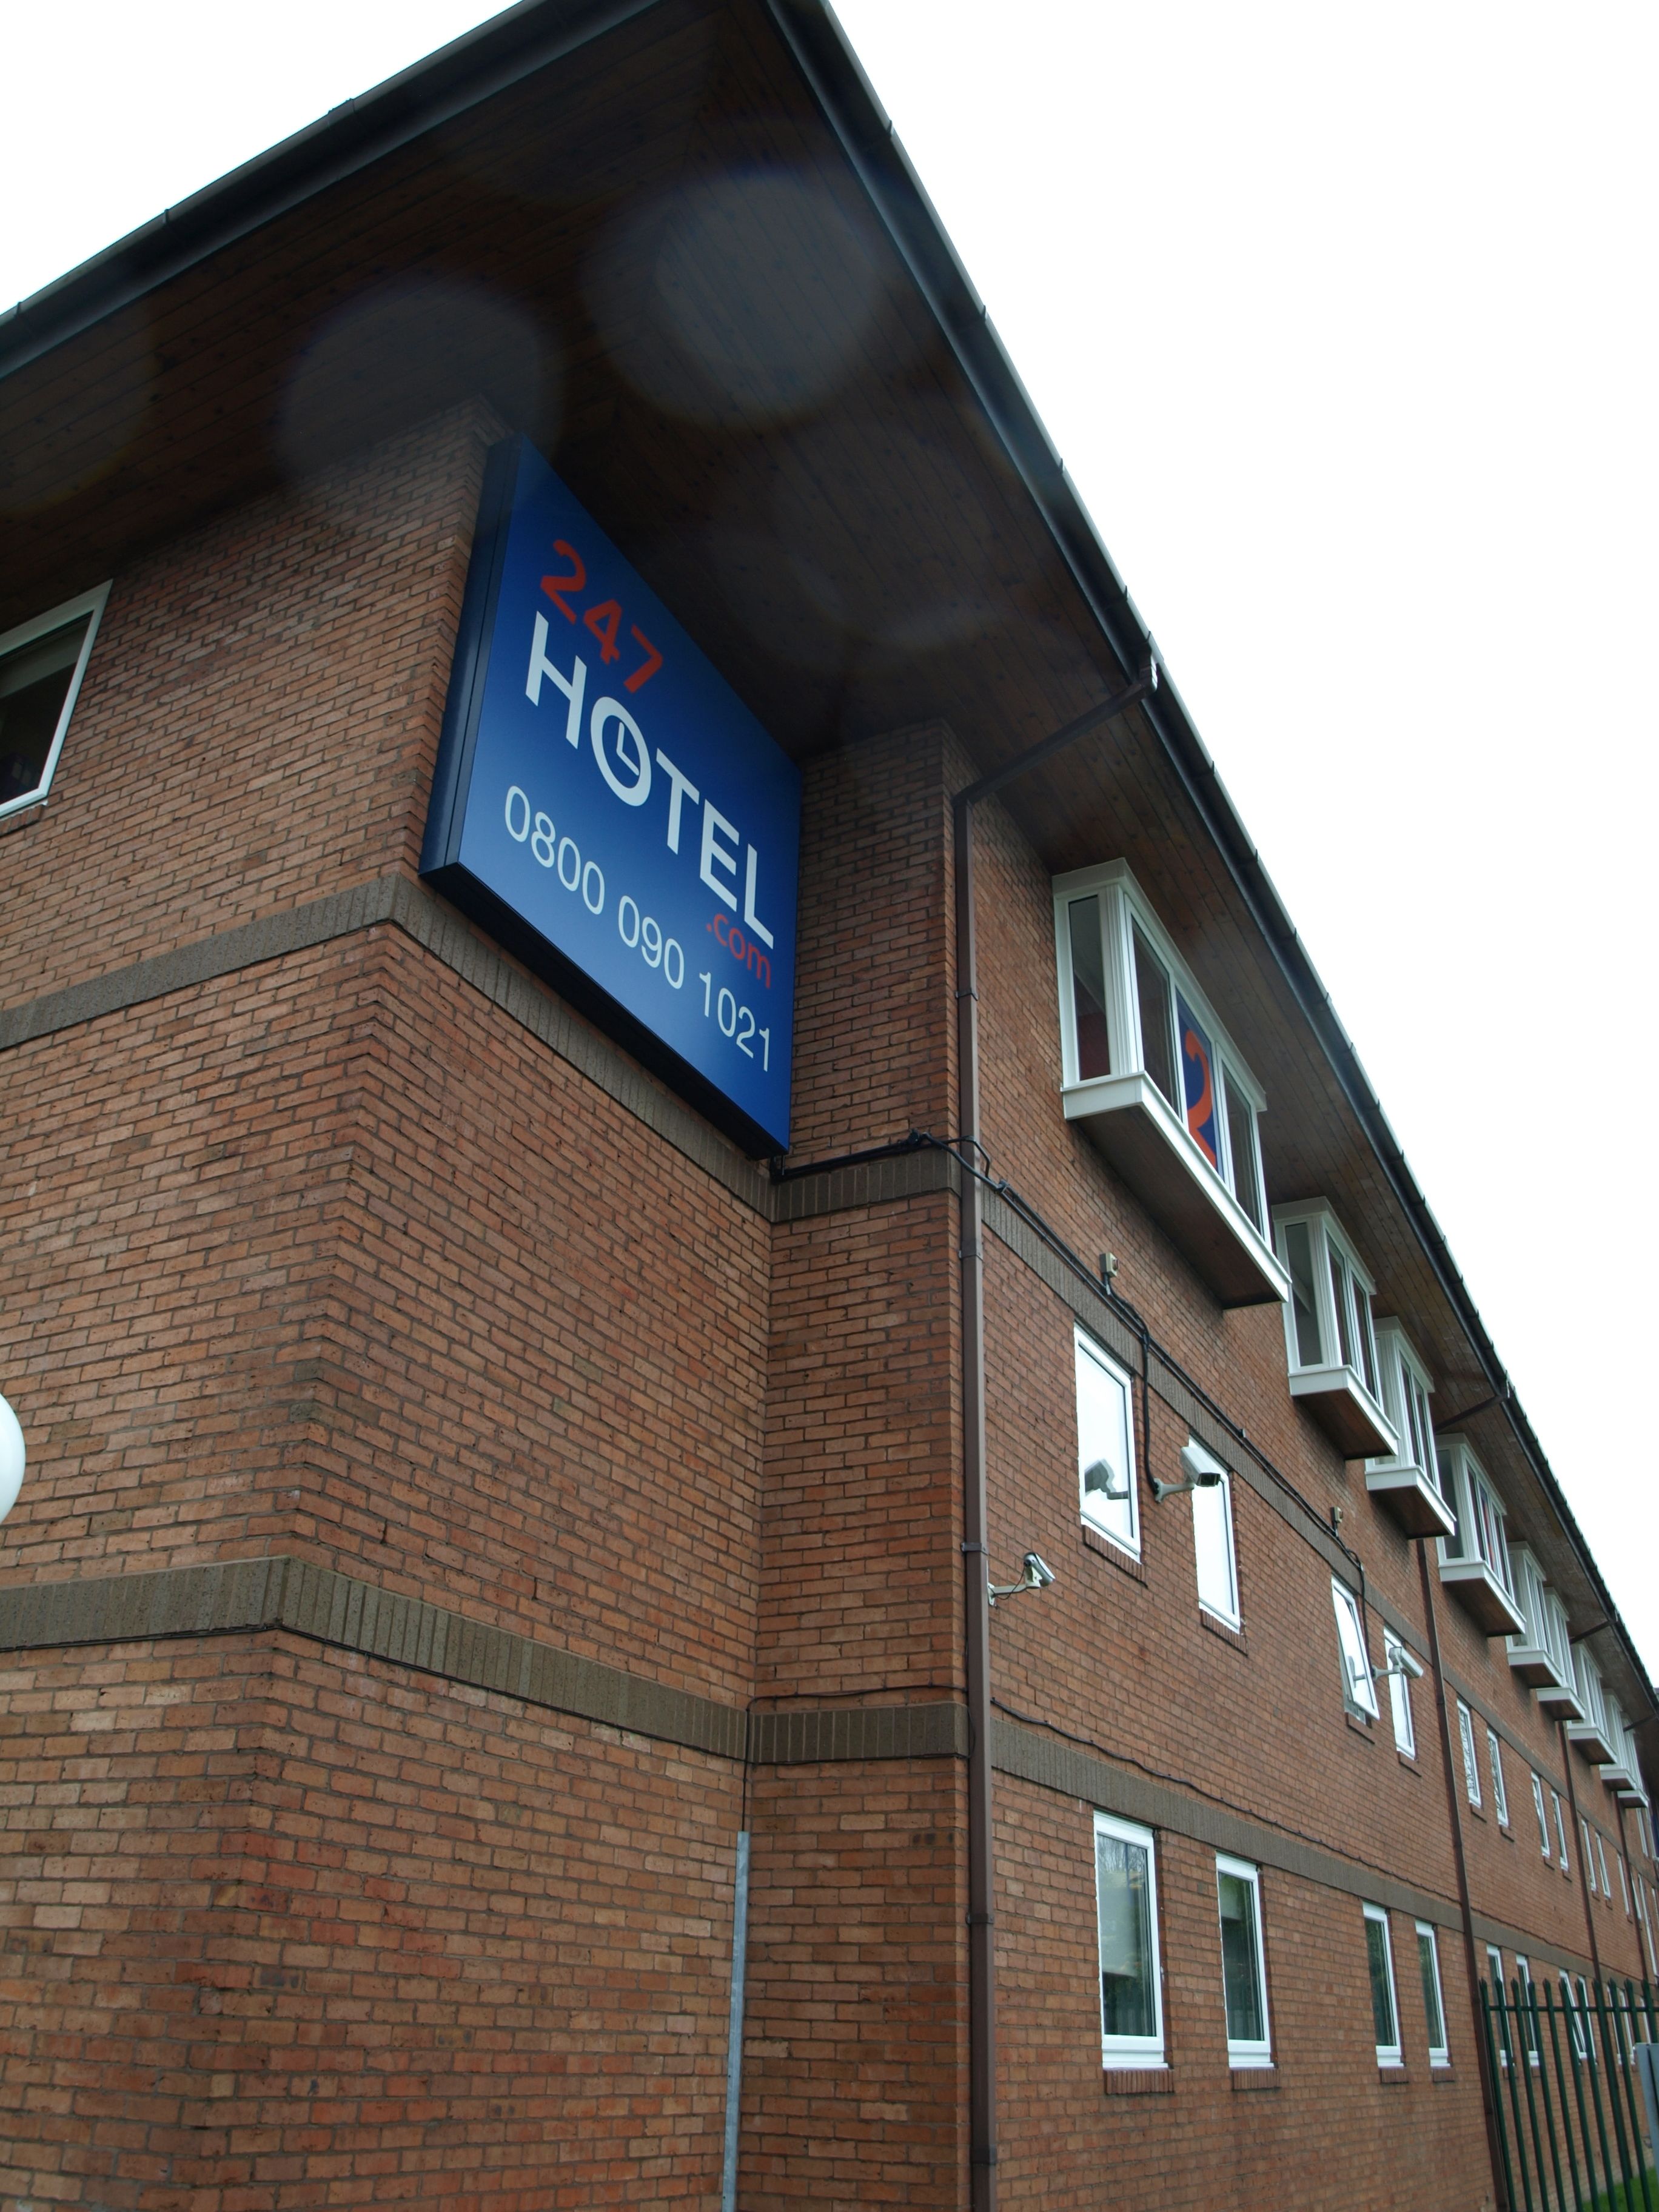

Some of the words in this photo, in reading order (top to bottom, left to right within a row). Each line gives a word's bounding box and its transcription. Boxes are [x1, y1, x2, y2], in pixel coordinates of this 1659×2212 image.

[540, 540, 663, 692] 247
[525, 611, 774, 948] HOTEL
[504, 785, 606, 914] 0800
[618, 895, 685, 990] 090
[699, 972, 771, 1071] 1021
[706, 913, 771, 988] .com
